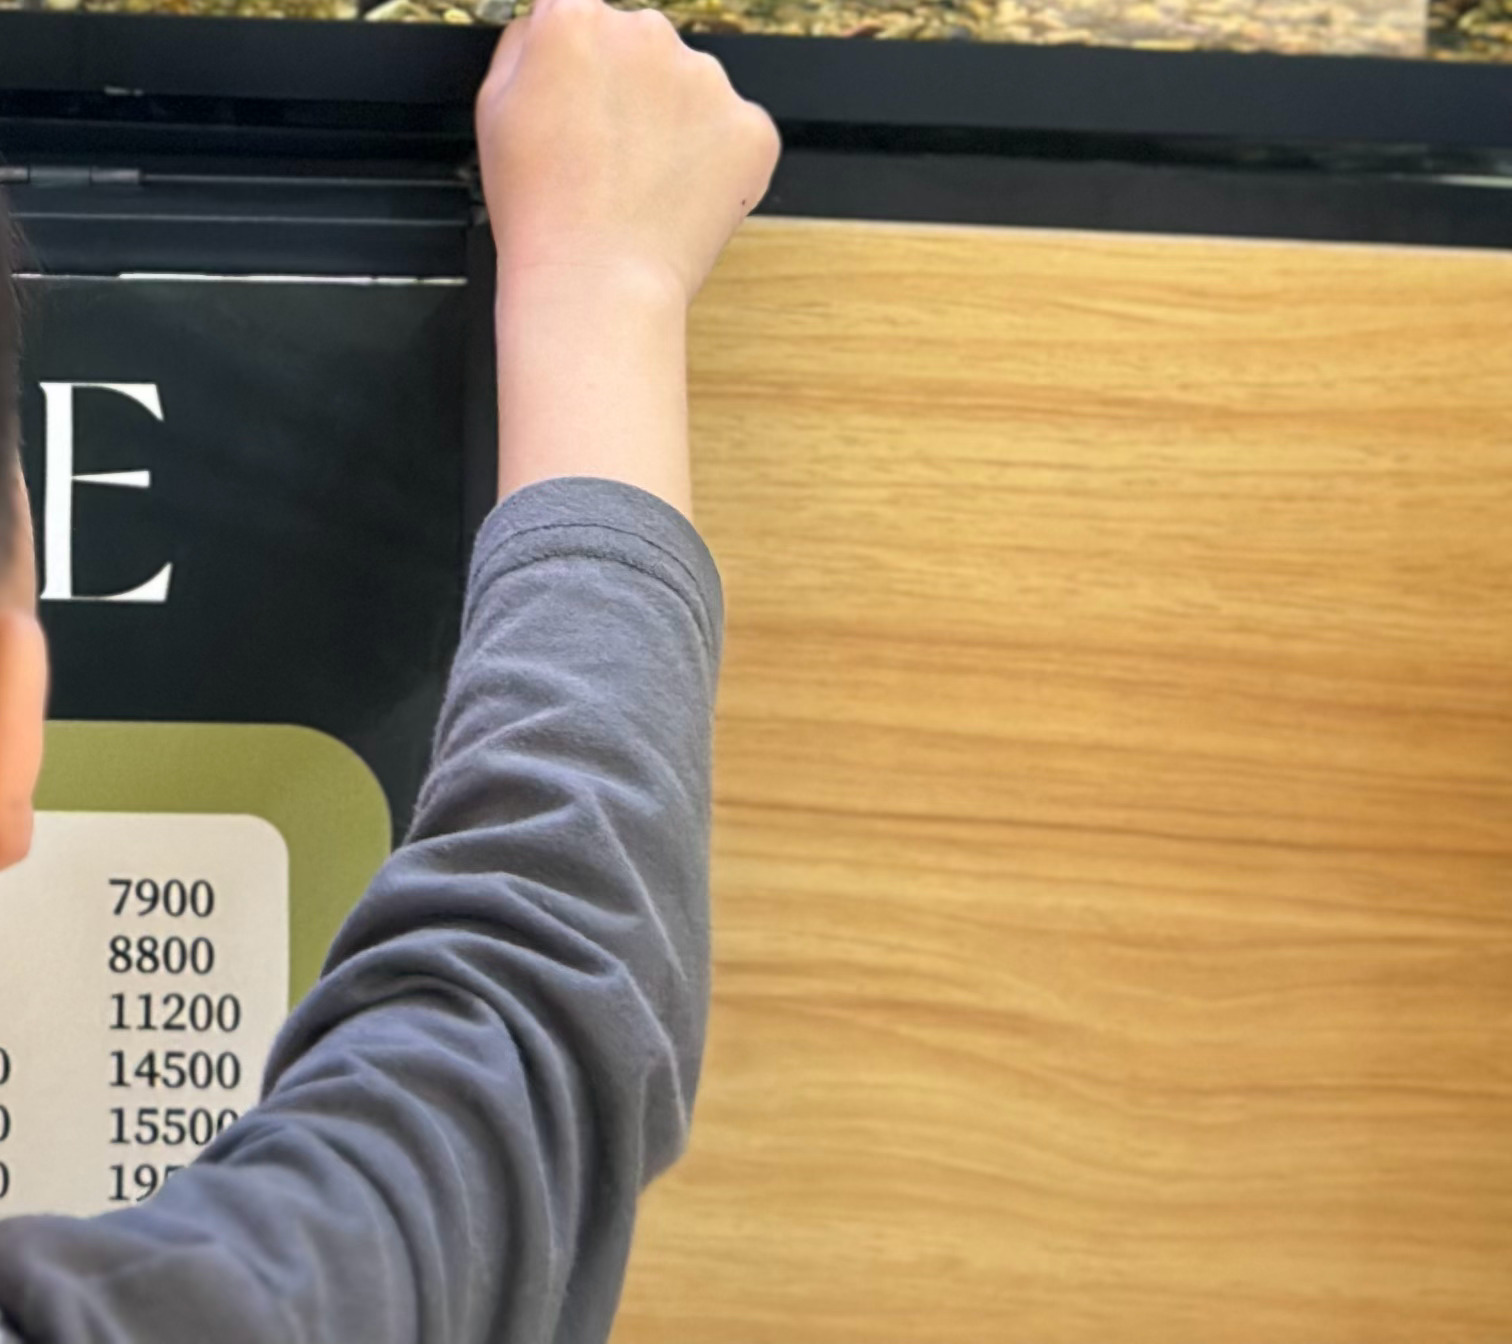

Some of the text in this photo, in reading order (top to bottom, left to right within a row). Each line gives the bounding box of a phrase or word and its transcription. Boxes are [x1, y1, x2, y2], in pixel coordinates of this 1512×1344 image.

[107, 878, 215, 918] 7900
[107, 935, 216, 975] 8800
[108, 993, 242, 1033] 11200
[108, 1050, 241, 1090] 14500
